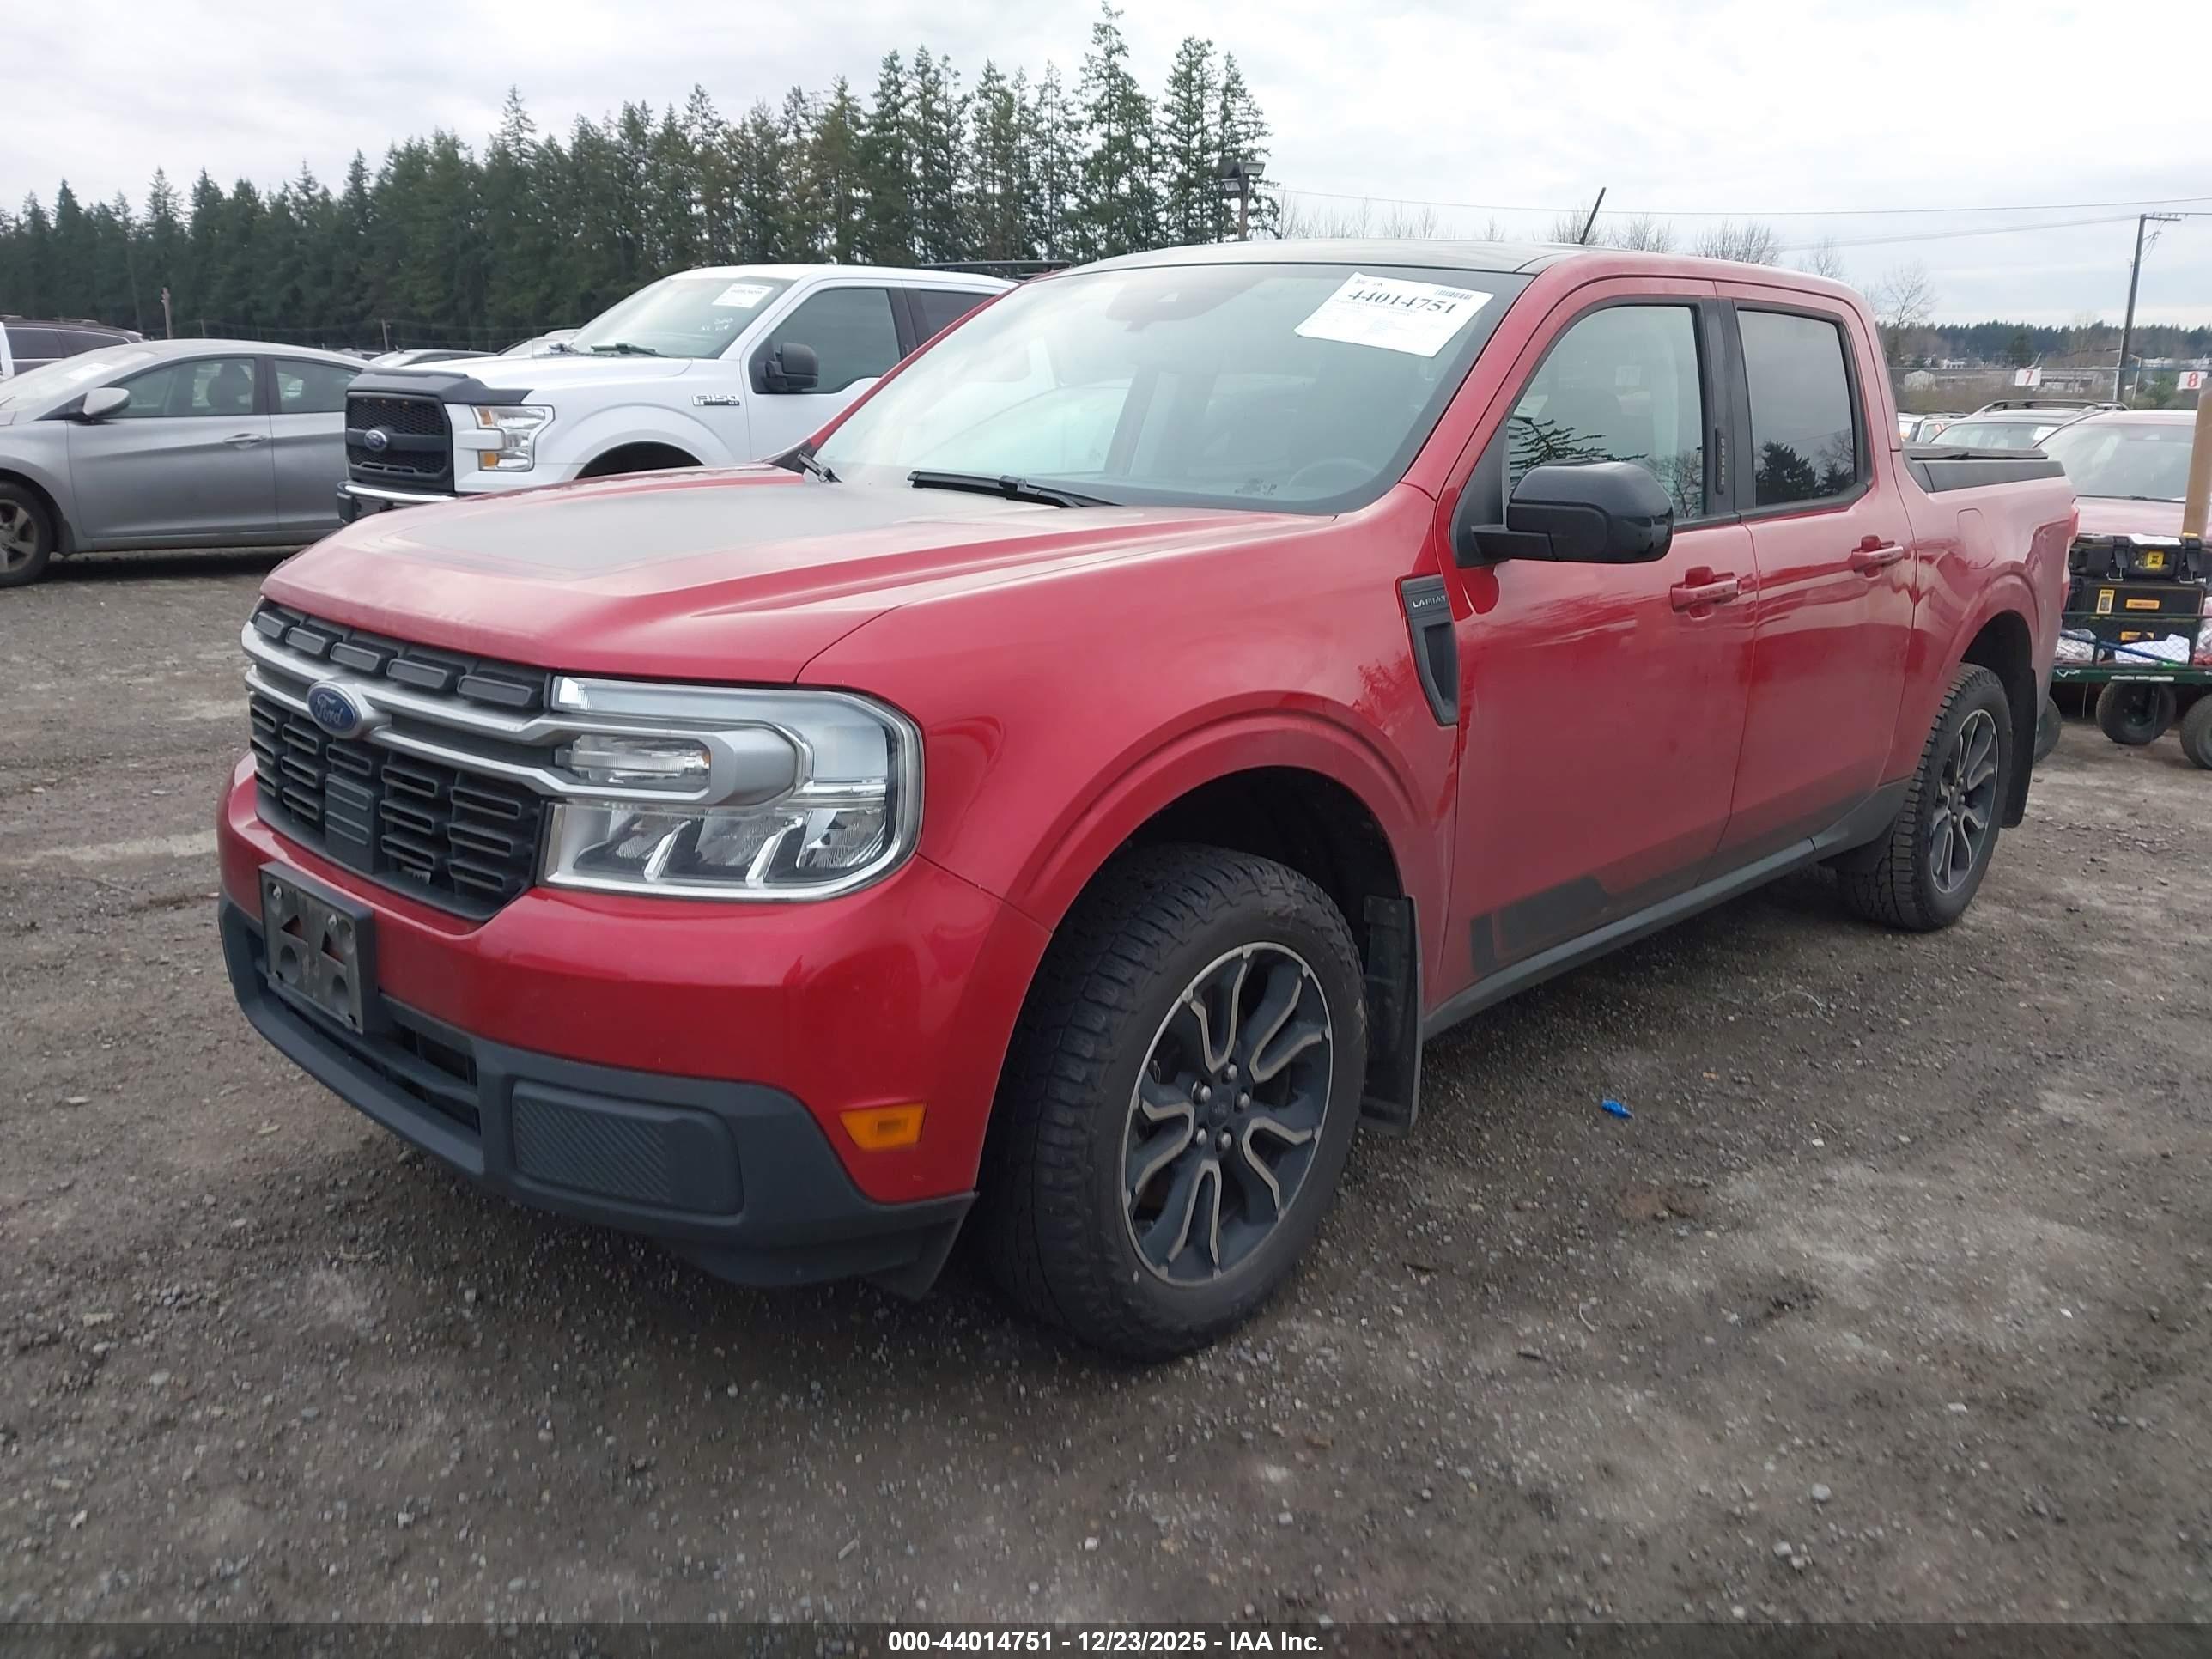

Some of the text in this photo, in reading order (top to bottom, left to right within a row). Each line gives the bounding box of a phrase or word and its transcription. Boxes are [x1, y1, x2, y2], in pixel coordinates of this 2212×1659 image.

[1348, 289, 1456, 313] 44014751
[2025, 370, 2034, 386] 7
[2187, 374, 2199, 389] 8
[1412, 595, 1446, 608] LARIAT
[315, 693, 343, 726] Ford
